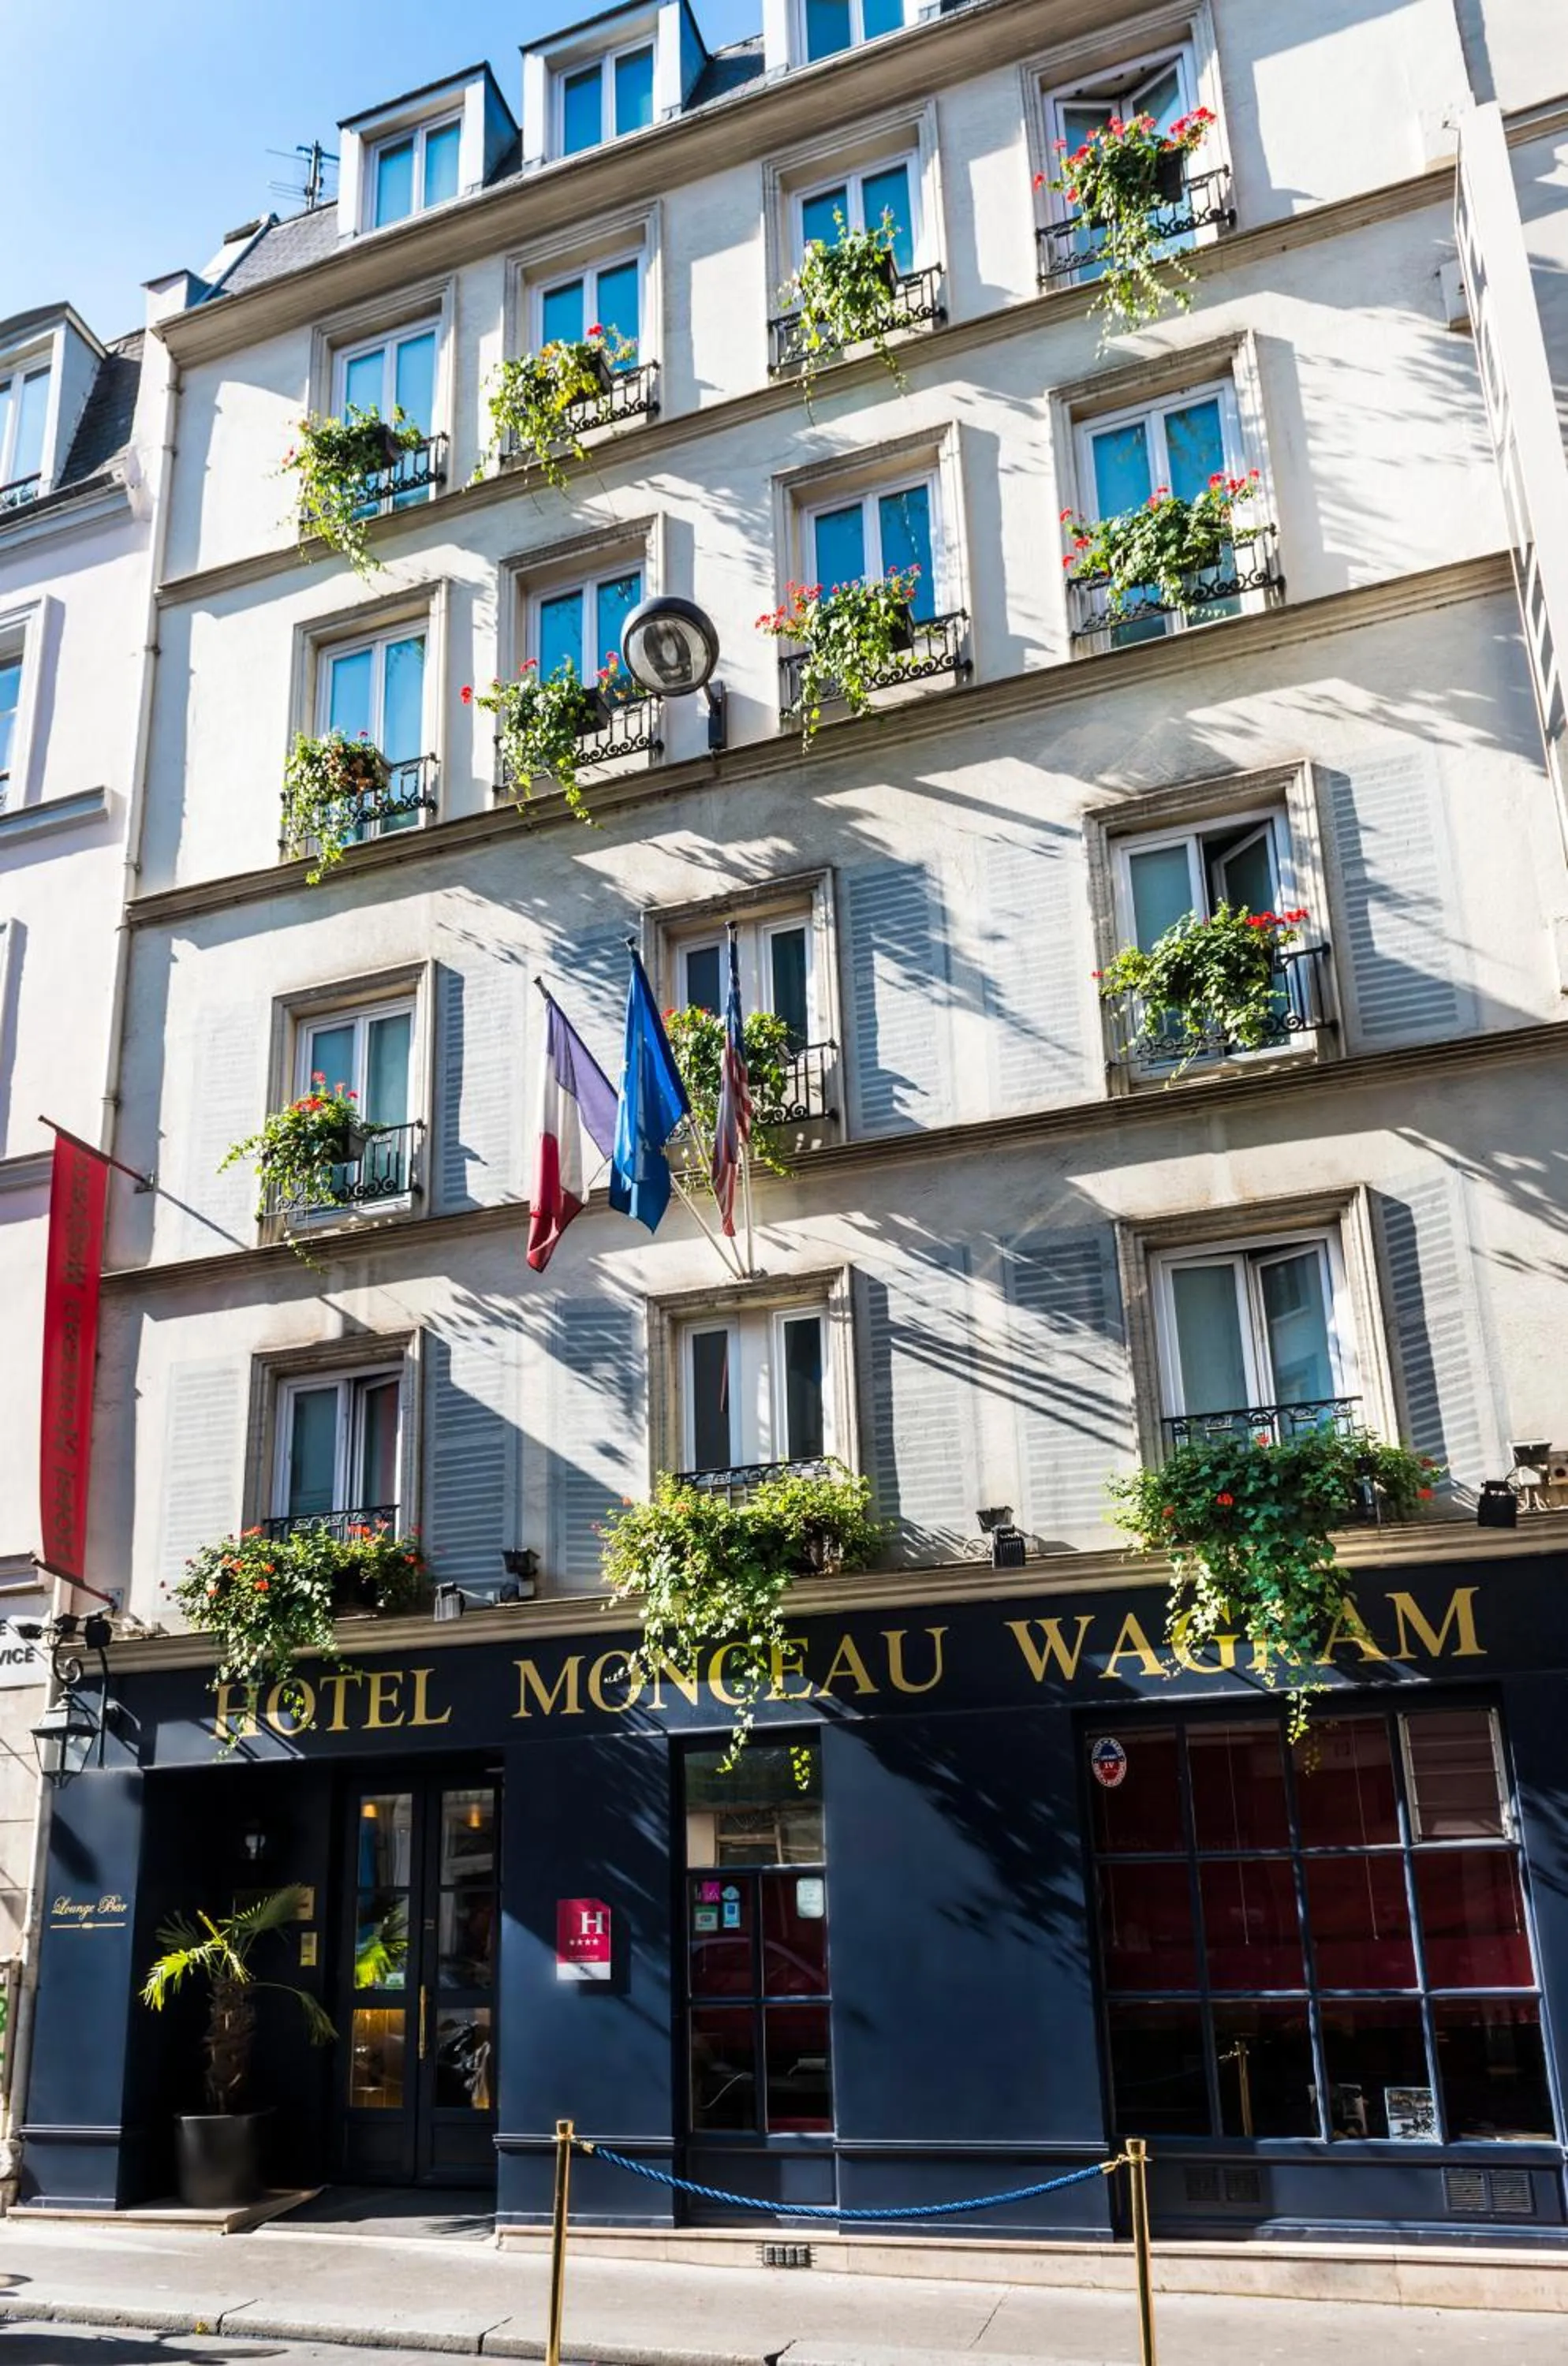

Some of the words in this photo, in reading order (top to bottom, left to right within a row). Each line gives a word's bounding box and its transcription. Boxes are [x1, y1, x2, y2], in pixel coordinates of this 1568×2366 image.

[209, 1667, 452, 1739] HOTEL
[511, 1627, 949, 1718] MONCEAU
[51, 1895, 95, 1920] Lounge
[98, 1894, 128, 1913] Bar
[580, 1911, 605, 1935] H
